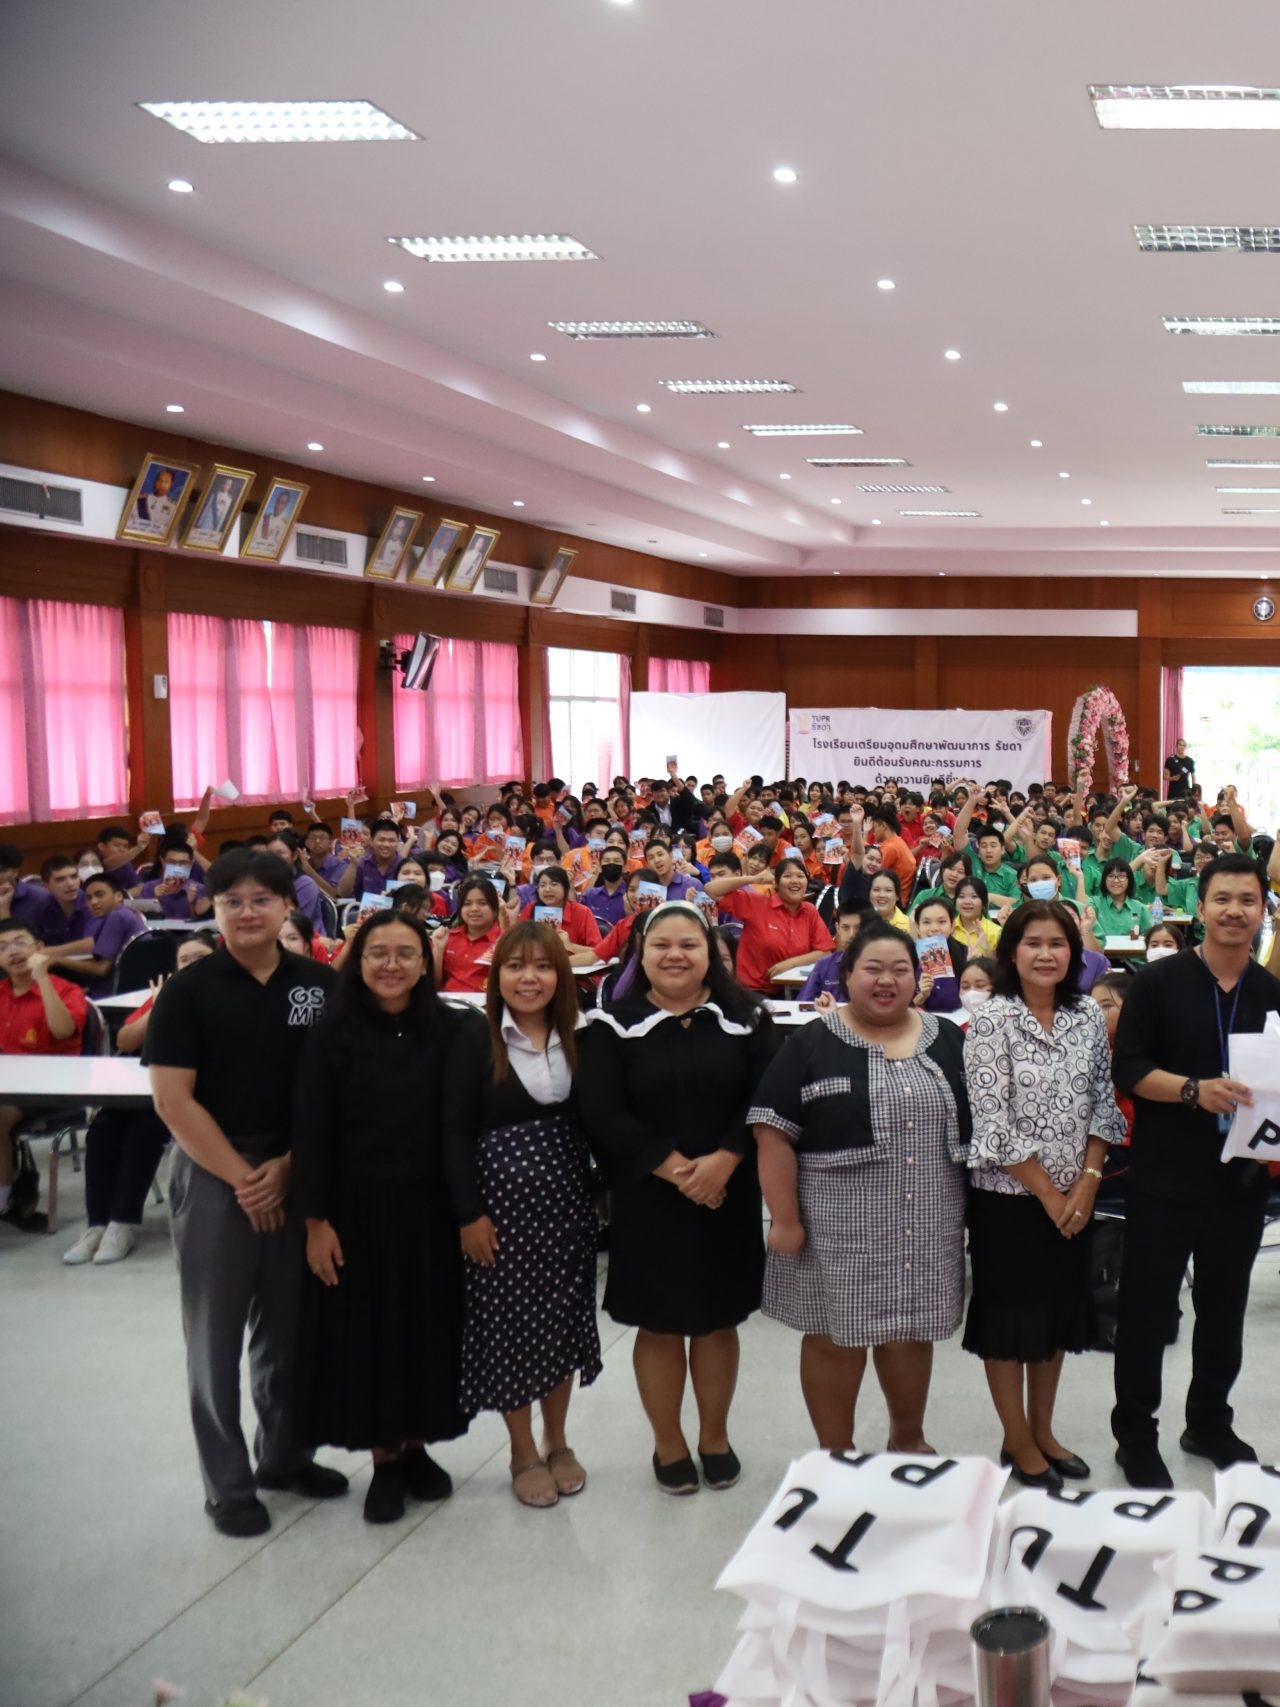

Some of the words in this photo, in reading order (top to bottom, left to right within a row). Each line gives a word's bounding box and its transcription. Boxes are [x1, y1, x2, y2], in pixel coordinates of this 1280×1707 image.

[813, 738, 990, 752] โรงเรียนเตรียมอุดมศึกษาพัฒนาการ
[995, 740, 1022, 751] รัชดา
[853, 755, 982, 768] ยินดีต้อนรับคณะกรรมการ
